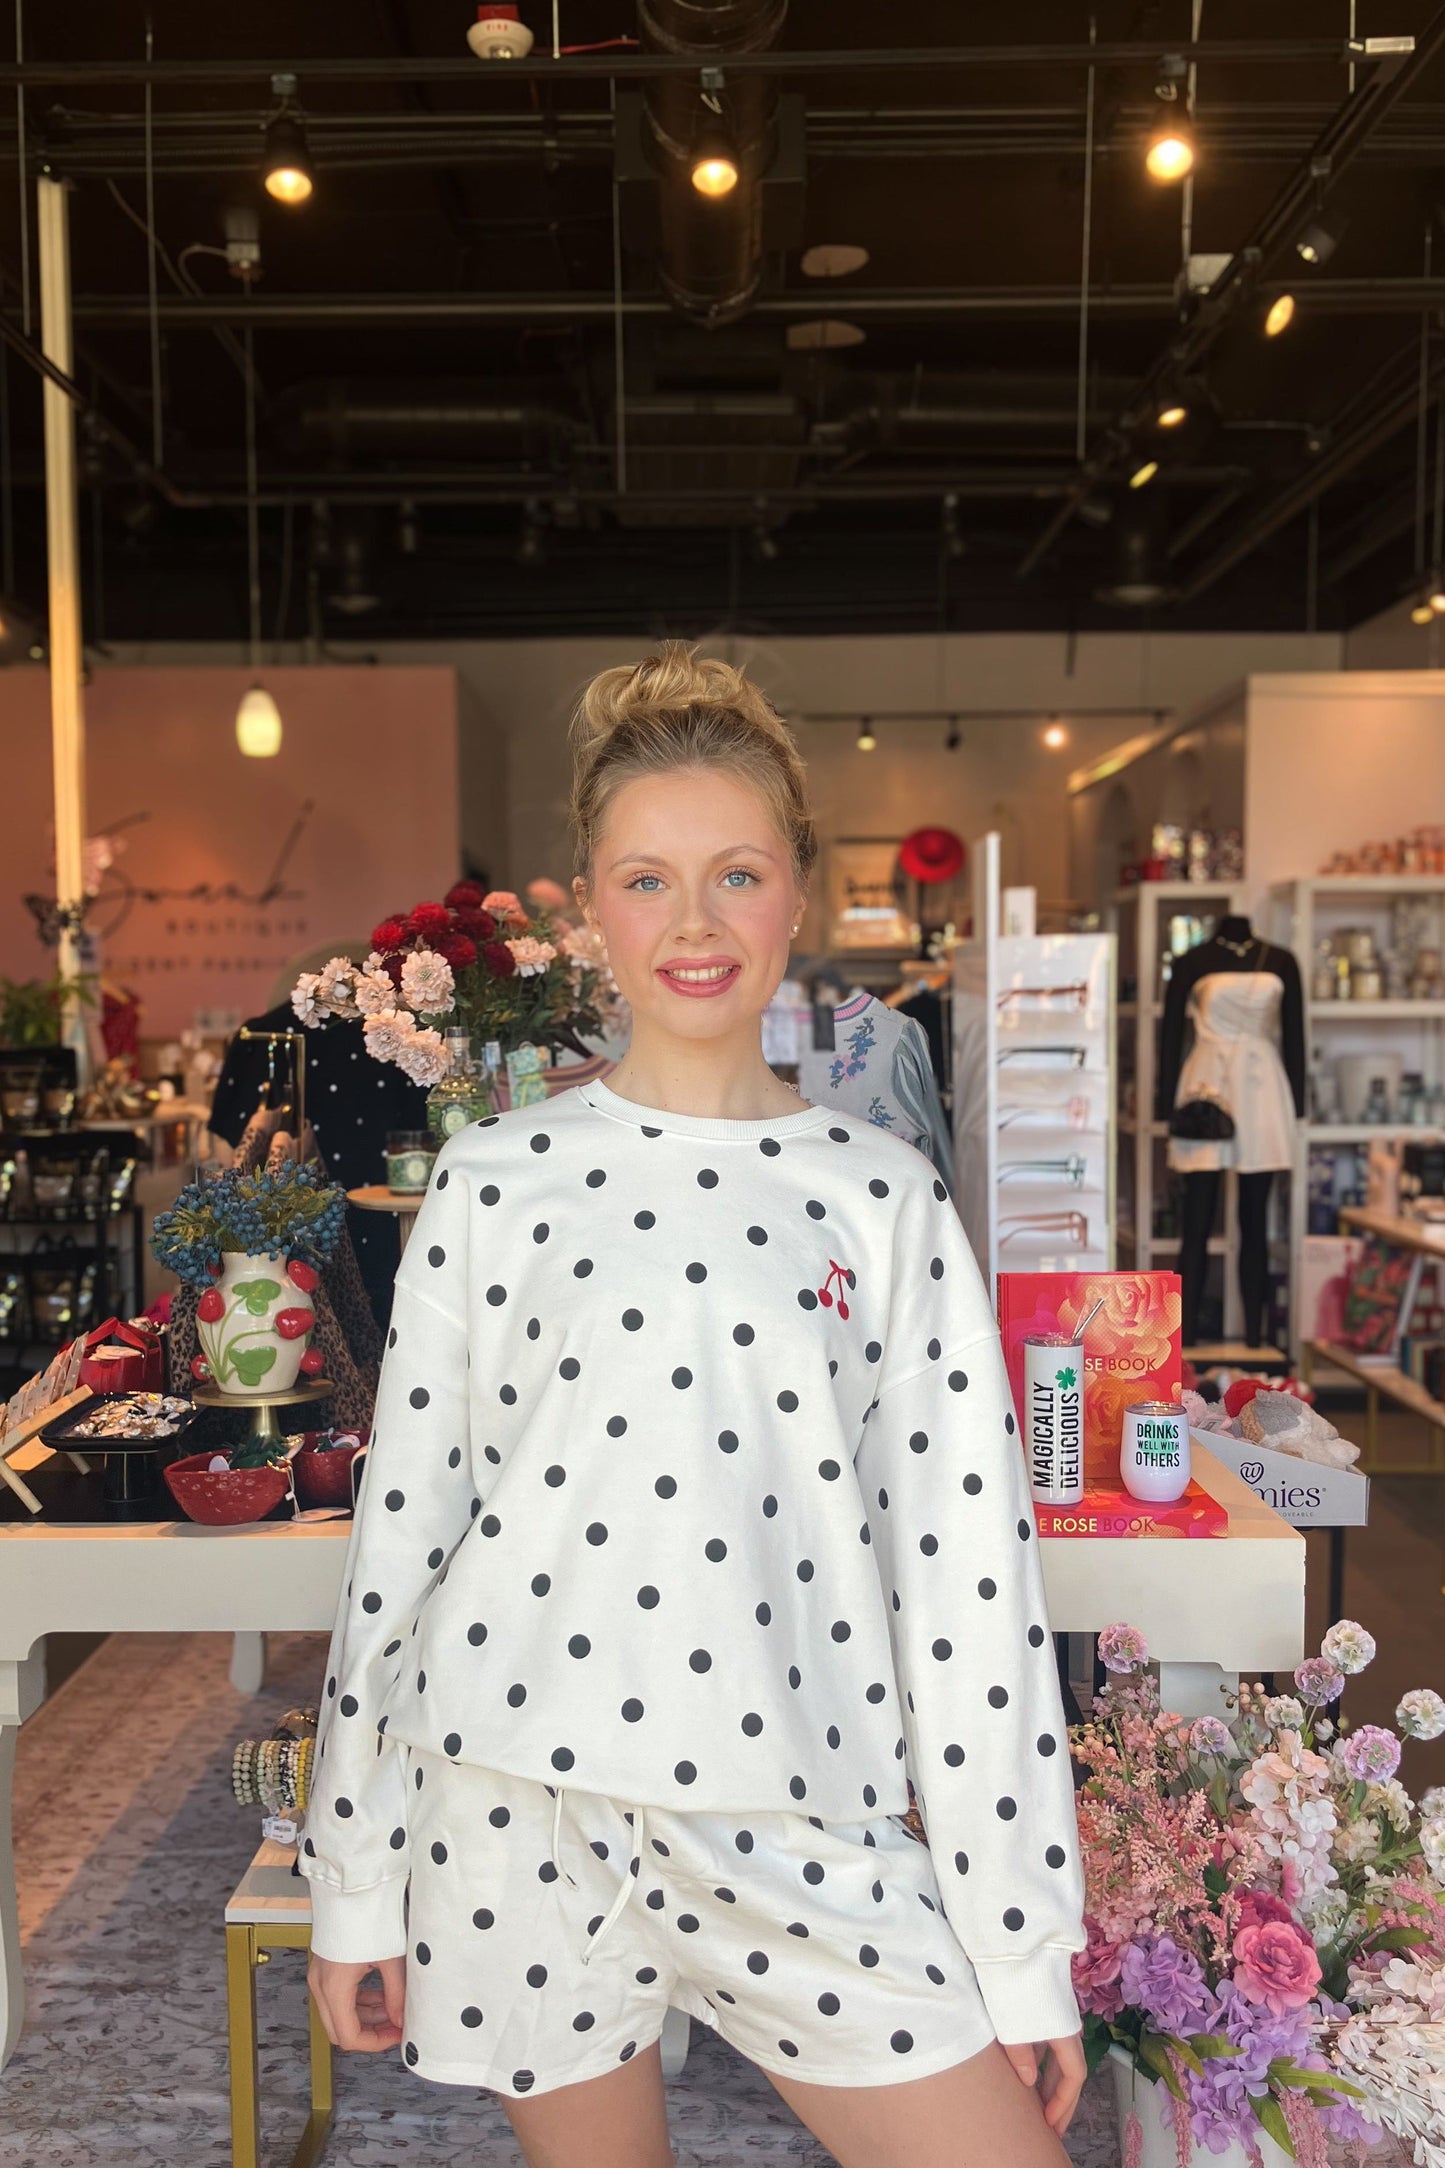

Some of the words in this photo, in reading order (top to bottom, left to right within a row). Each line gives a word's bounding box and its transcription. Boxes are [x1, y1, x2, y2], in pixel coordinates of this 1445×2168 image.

[1108, 1358, 1157, 1372] BOOK
[1033, 1381, 1054, 1489] MAGICALLY
[1137, 1423, 1180, 1439] DRINKS
[1060, 1392, 1080, 1489] DELICIOUS
[1137, 1440, 1159, 1451] WELL
[1161, 1441, 1180, 1451] WITH
[1135, 1451, 1180, 1468] OTHERS
[1053, 1517, 1098, 1532] ROSE
[1103, 1517, 1155, 1532] BOOK
